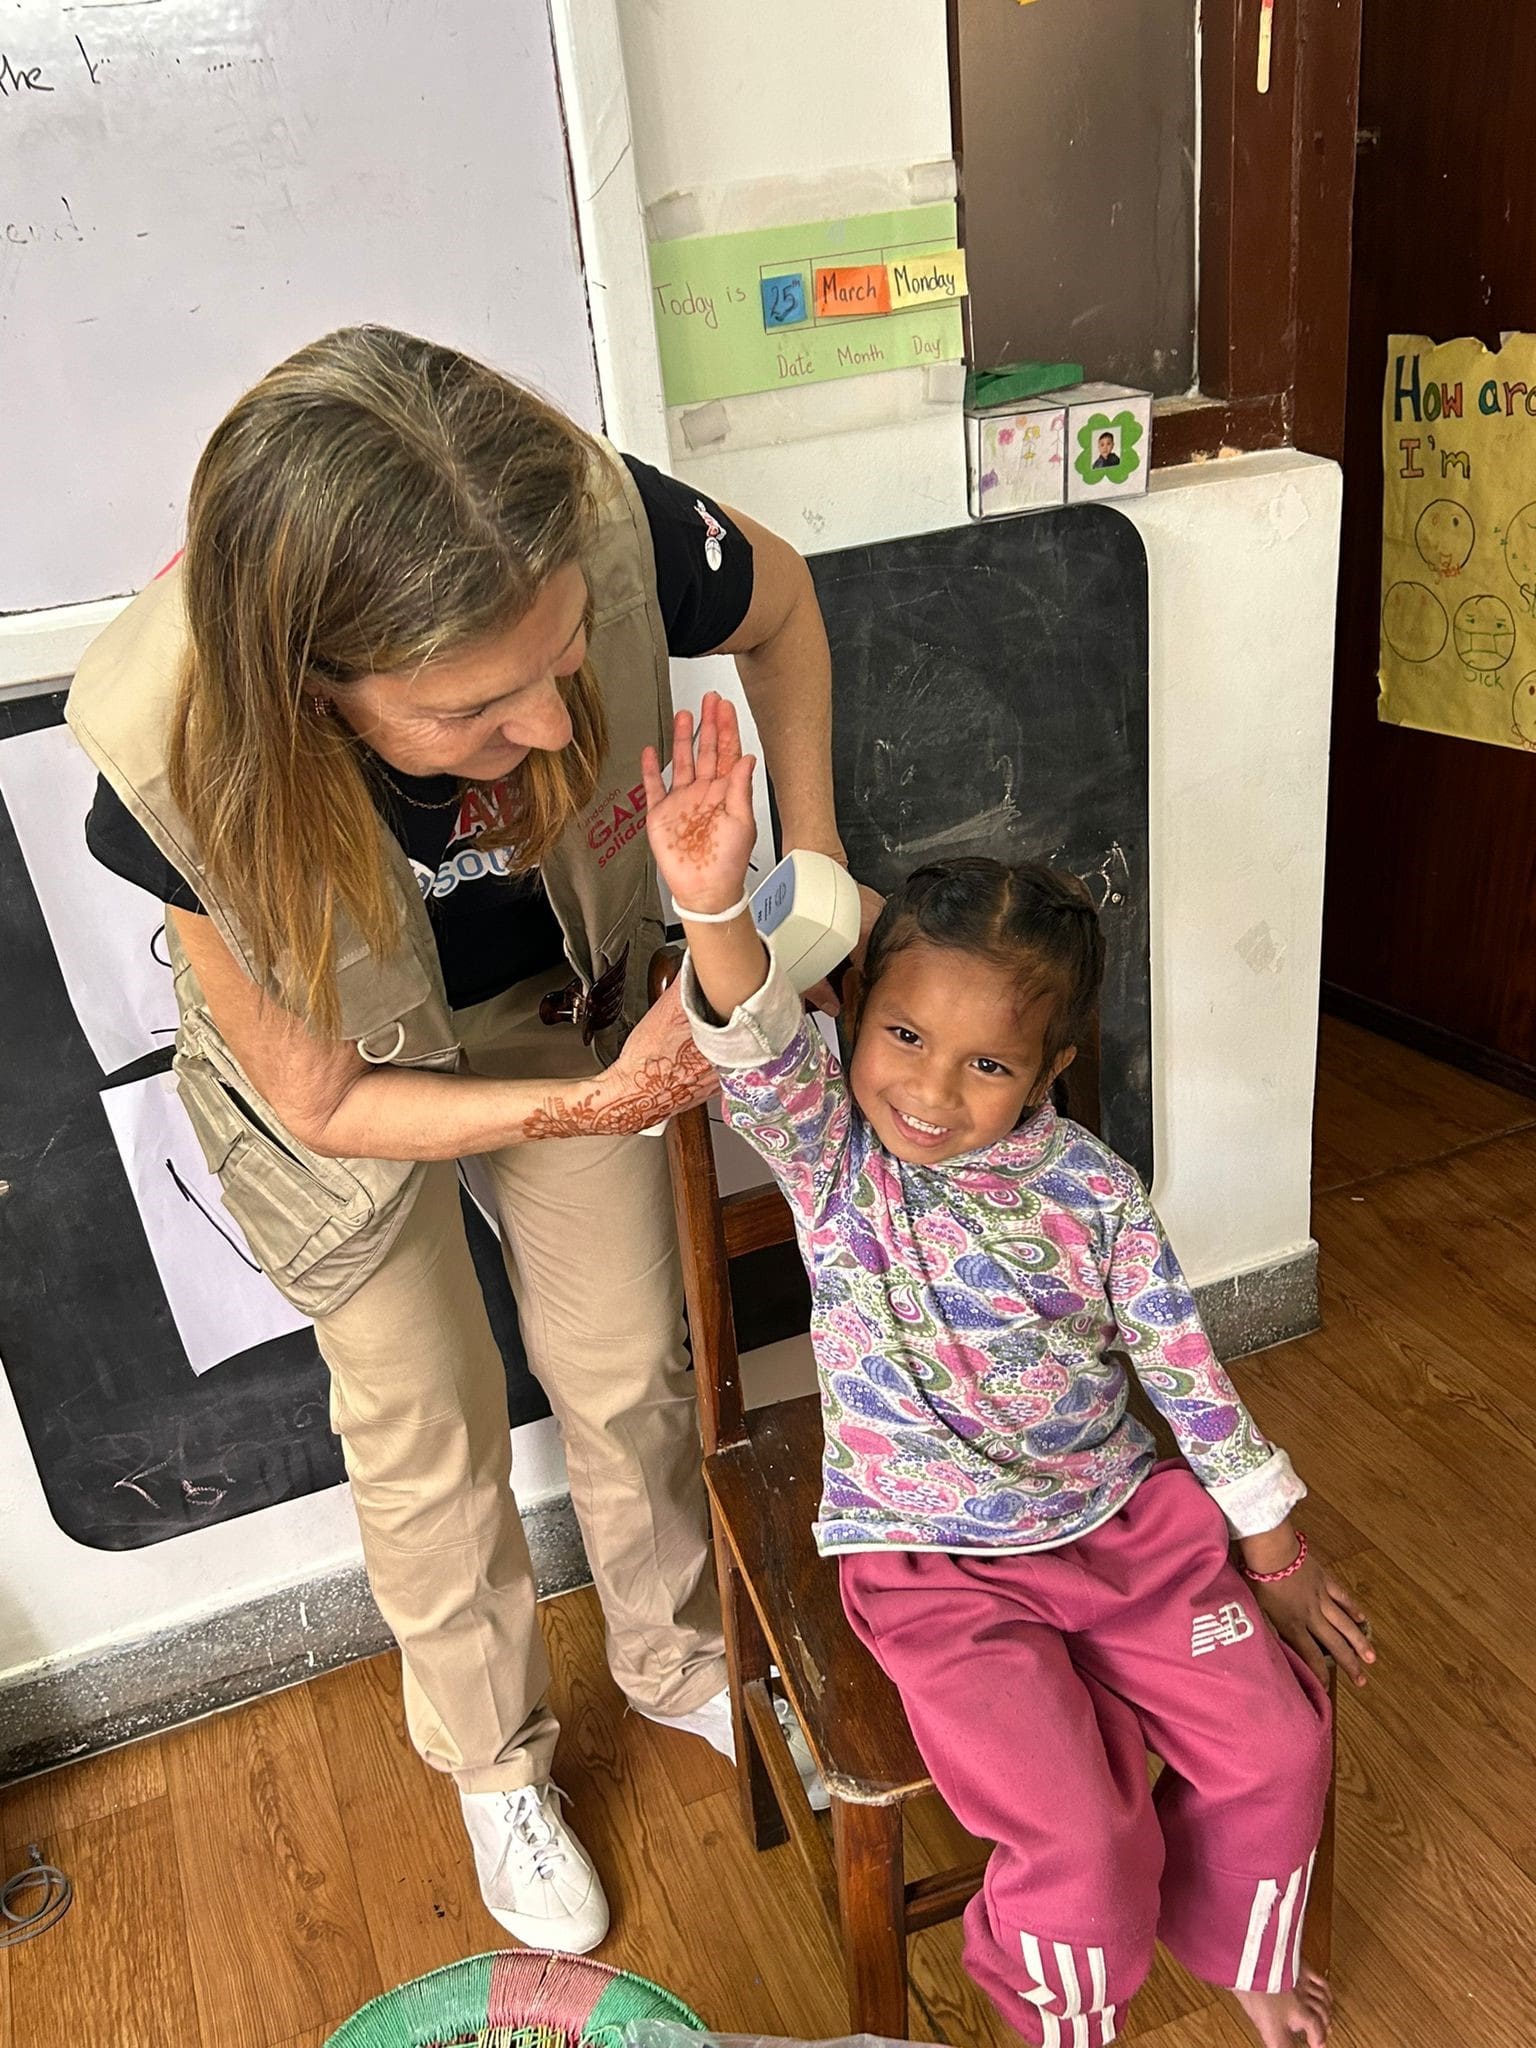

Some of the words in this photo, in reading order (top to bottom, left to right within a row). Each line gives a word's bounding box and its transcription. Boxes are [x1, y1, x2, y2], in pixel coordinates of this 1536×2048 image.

[653, 283, 718, 330] Today
[726, 286, 747, 304] is
[822, 274, 877, 305] March
[894, 265, 956, 298] Monday
[777, 354, 816, 380] Date
[837, 343, 885, 367] Month
[913, 335, 942, 359] Day
[1394, 355, 1463, 422] How
[1399, 435, 1471, 480] I'm
[1463, 660, 1505, 691] Sick
[588, 782, 647, 849] GAE
[598, 815, 648, 869] solida
